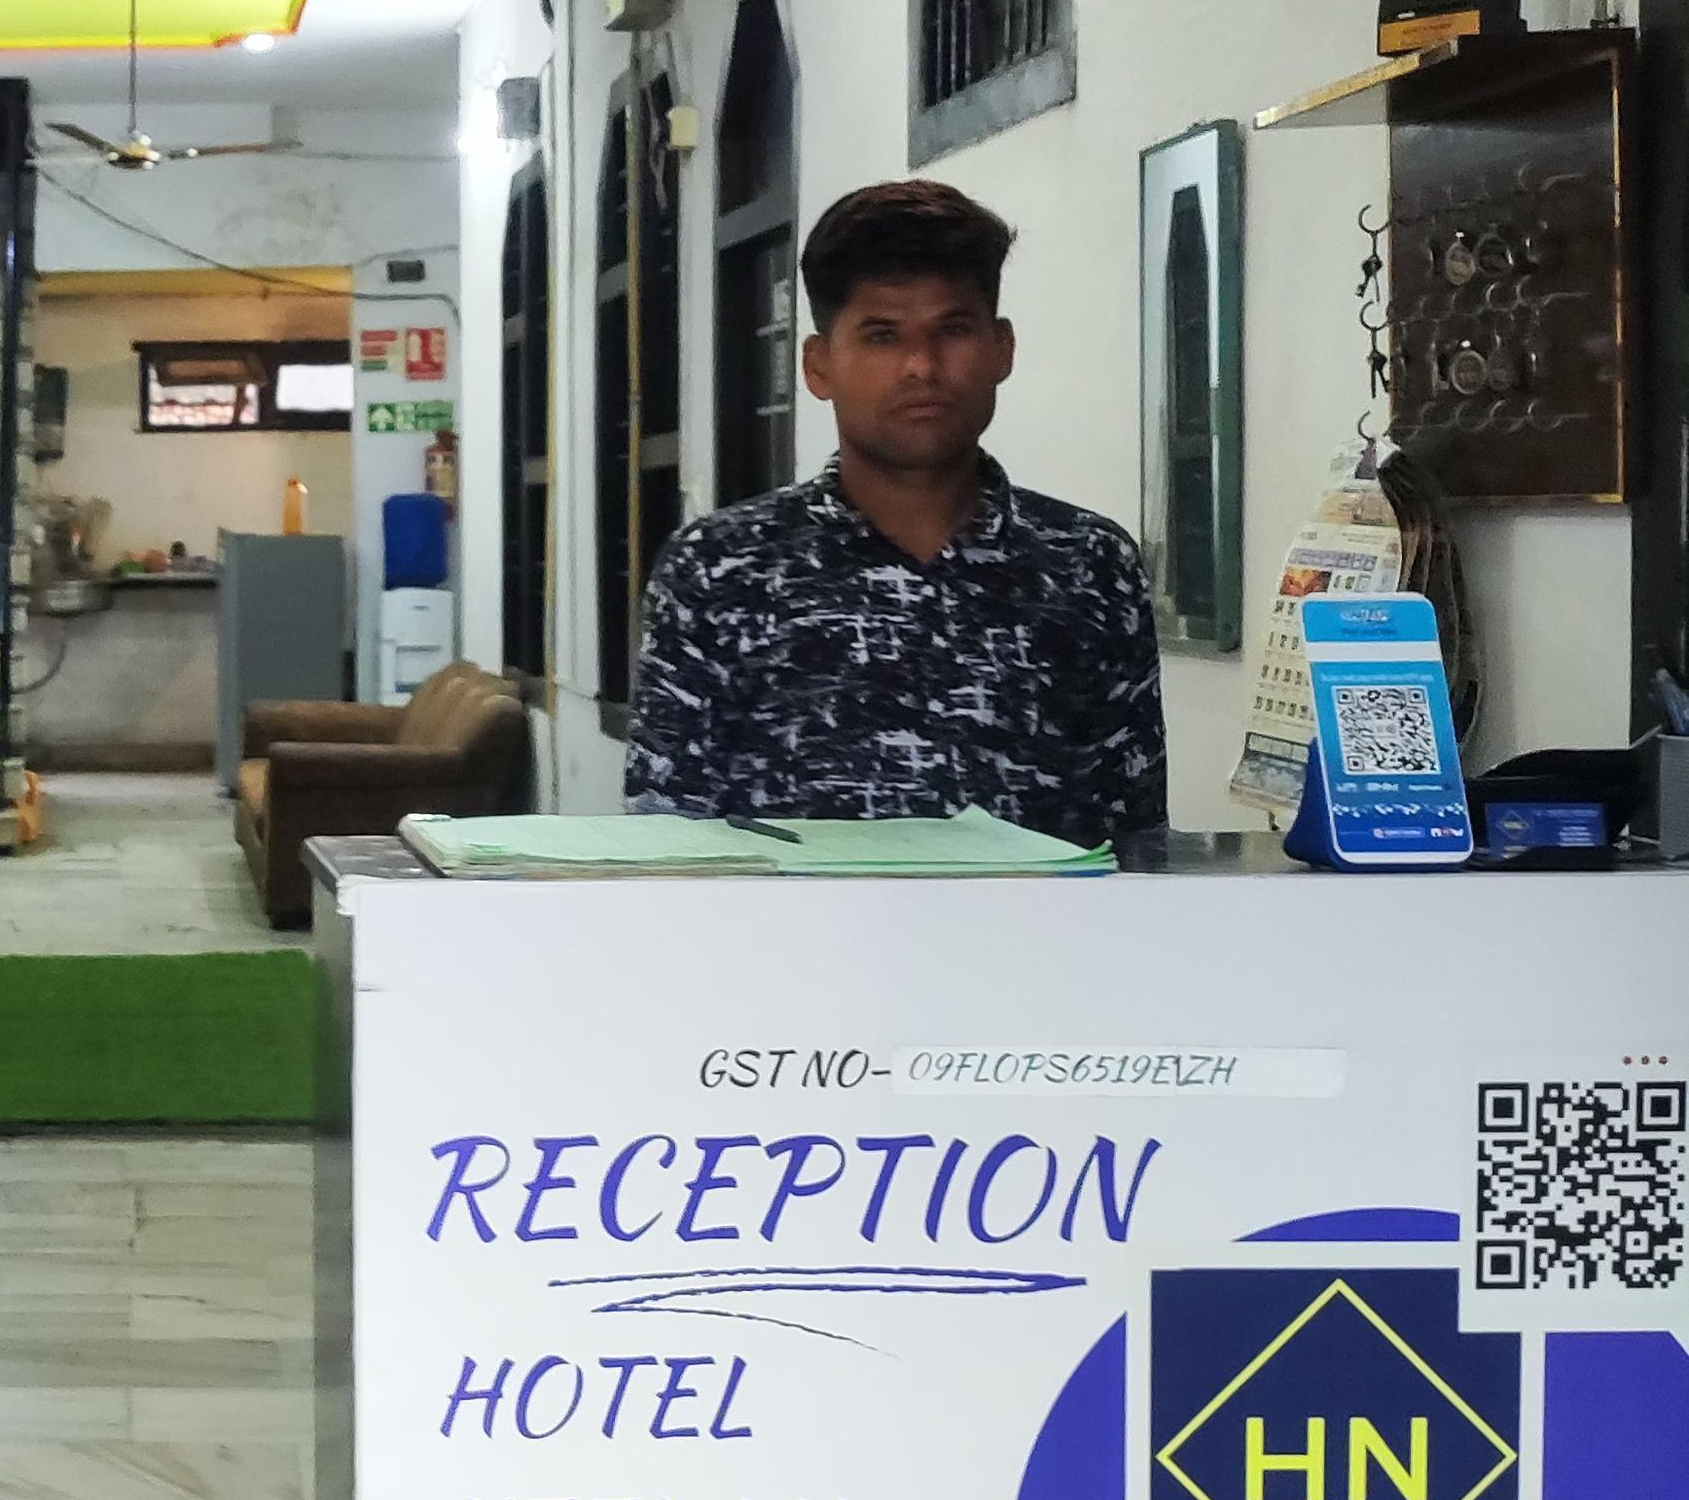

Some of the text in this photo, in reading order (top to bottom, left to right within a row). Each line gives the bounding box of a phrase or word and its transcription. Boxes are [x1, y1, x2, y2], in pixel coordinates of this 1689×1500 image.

[700, 1049, 794, 1088] GST
[801, 1049, 891, 1088] NO-
[427, 1135, 1163, 1244] RECEPTION
[441, 1356, 752, 1440] HOTEL
